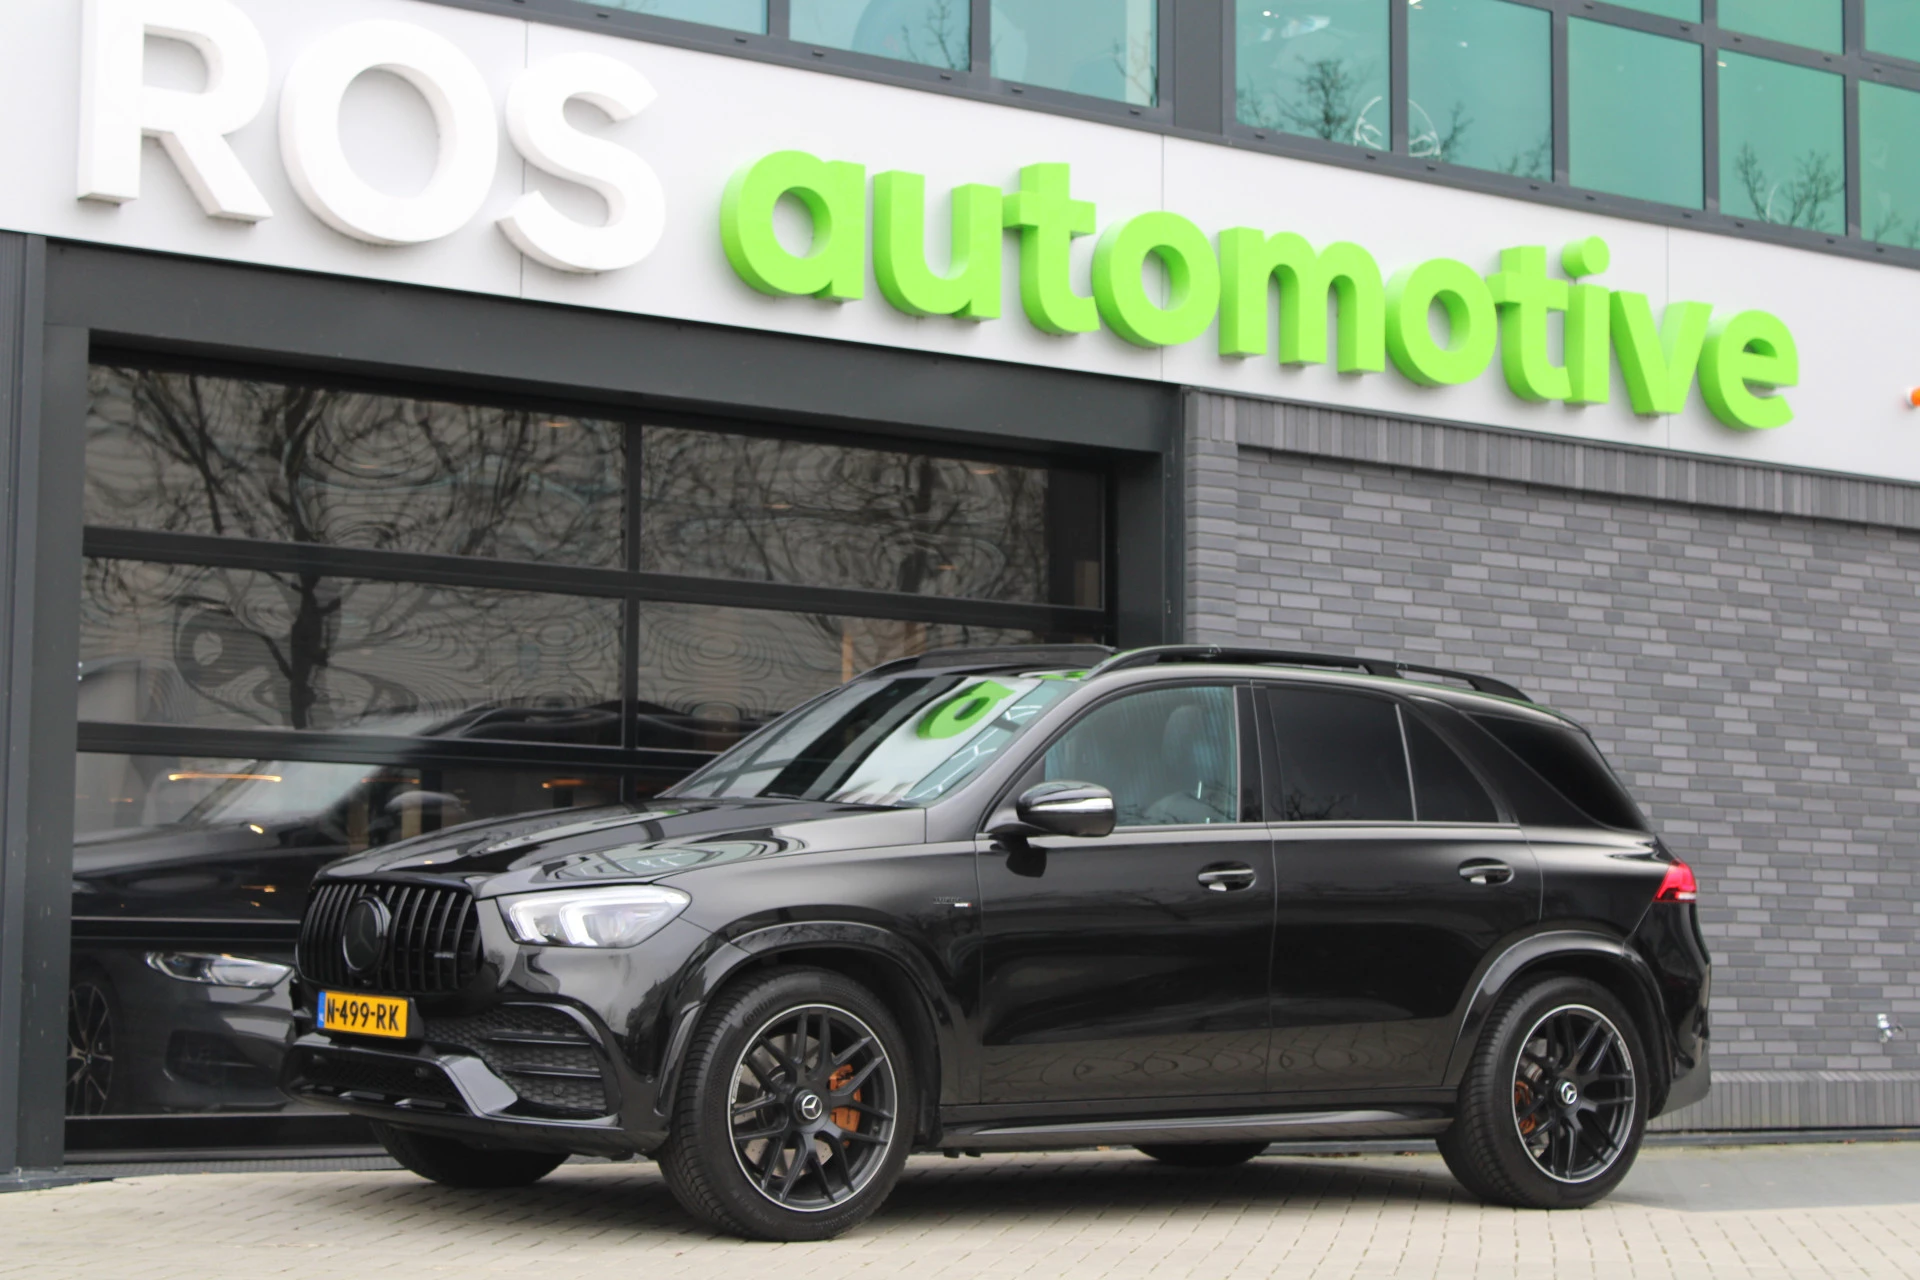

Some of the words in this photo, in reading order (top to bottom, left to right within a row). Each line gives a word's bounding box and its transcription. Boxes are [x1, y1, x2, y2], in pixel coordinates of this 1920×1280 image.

[78, 0, 666, 273] ROS
[719, 150, 1798, 430] automotive
[327, 998, 399, 1030] N-499-RK
